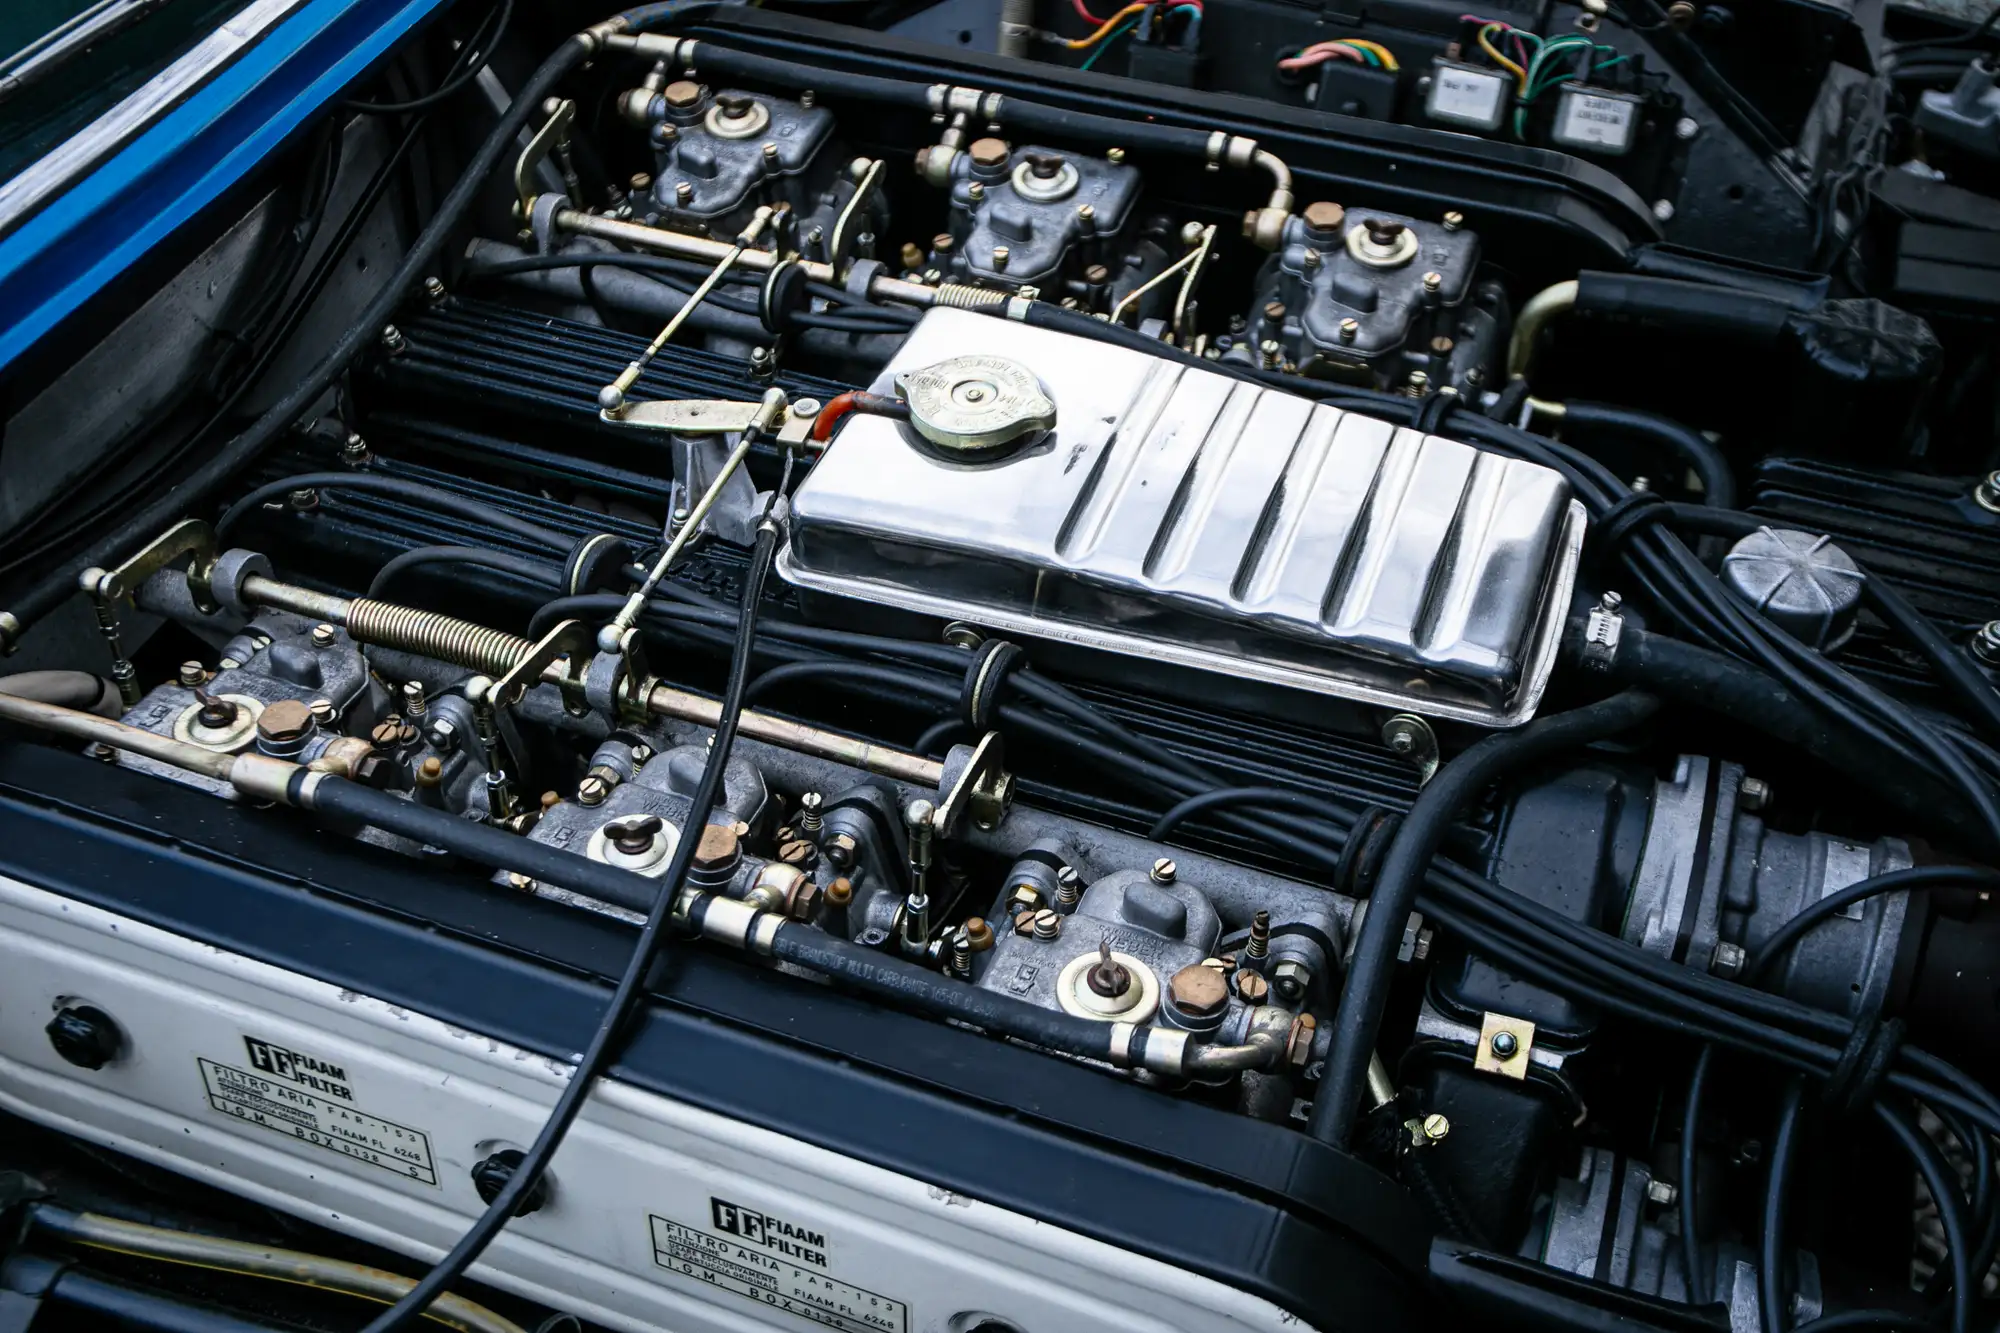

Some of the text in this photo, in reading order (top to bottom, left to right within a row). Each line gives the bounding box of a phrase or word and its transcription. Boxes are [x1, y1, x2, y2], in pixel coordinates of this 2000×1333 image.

[847, 959, 875, 980] MULTI
[291, 1052, 346, 1081] FIAAM
[213, 1065, 270, 1093] FILTRO
[277, 1088, 317, 1109] ARIA
[299, 1071, 354, 1101] FILTER
[295, 1126, 335, 1149] BOX
[343, 1144, 379, 1163] 0138
[331, 1124, 421, 1161] FIAAM FL 6248
[409, 1166, 419, 1177] S
[666, 1223, 729, 1253] FILTRO
[737, 1249, 781, 1272] ARIA
[668, 1234, 721, 1257] ATTENZIONE
[765, 1215, 825, 1248] FIAAM
[669, 1242, 779, 1285] USARE ESCLUSIVAMENTE
[767, 1234, 828, 1268] FILTER
[670, 1248, 780, 1291] LA CARTUCCIA ORIGINALE
[749, 1286, 793, 1311] BOX
[794, 1287, 894, 1329] FIAAM FL 6248
